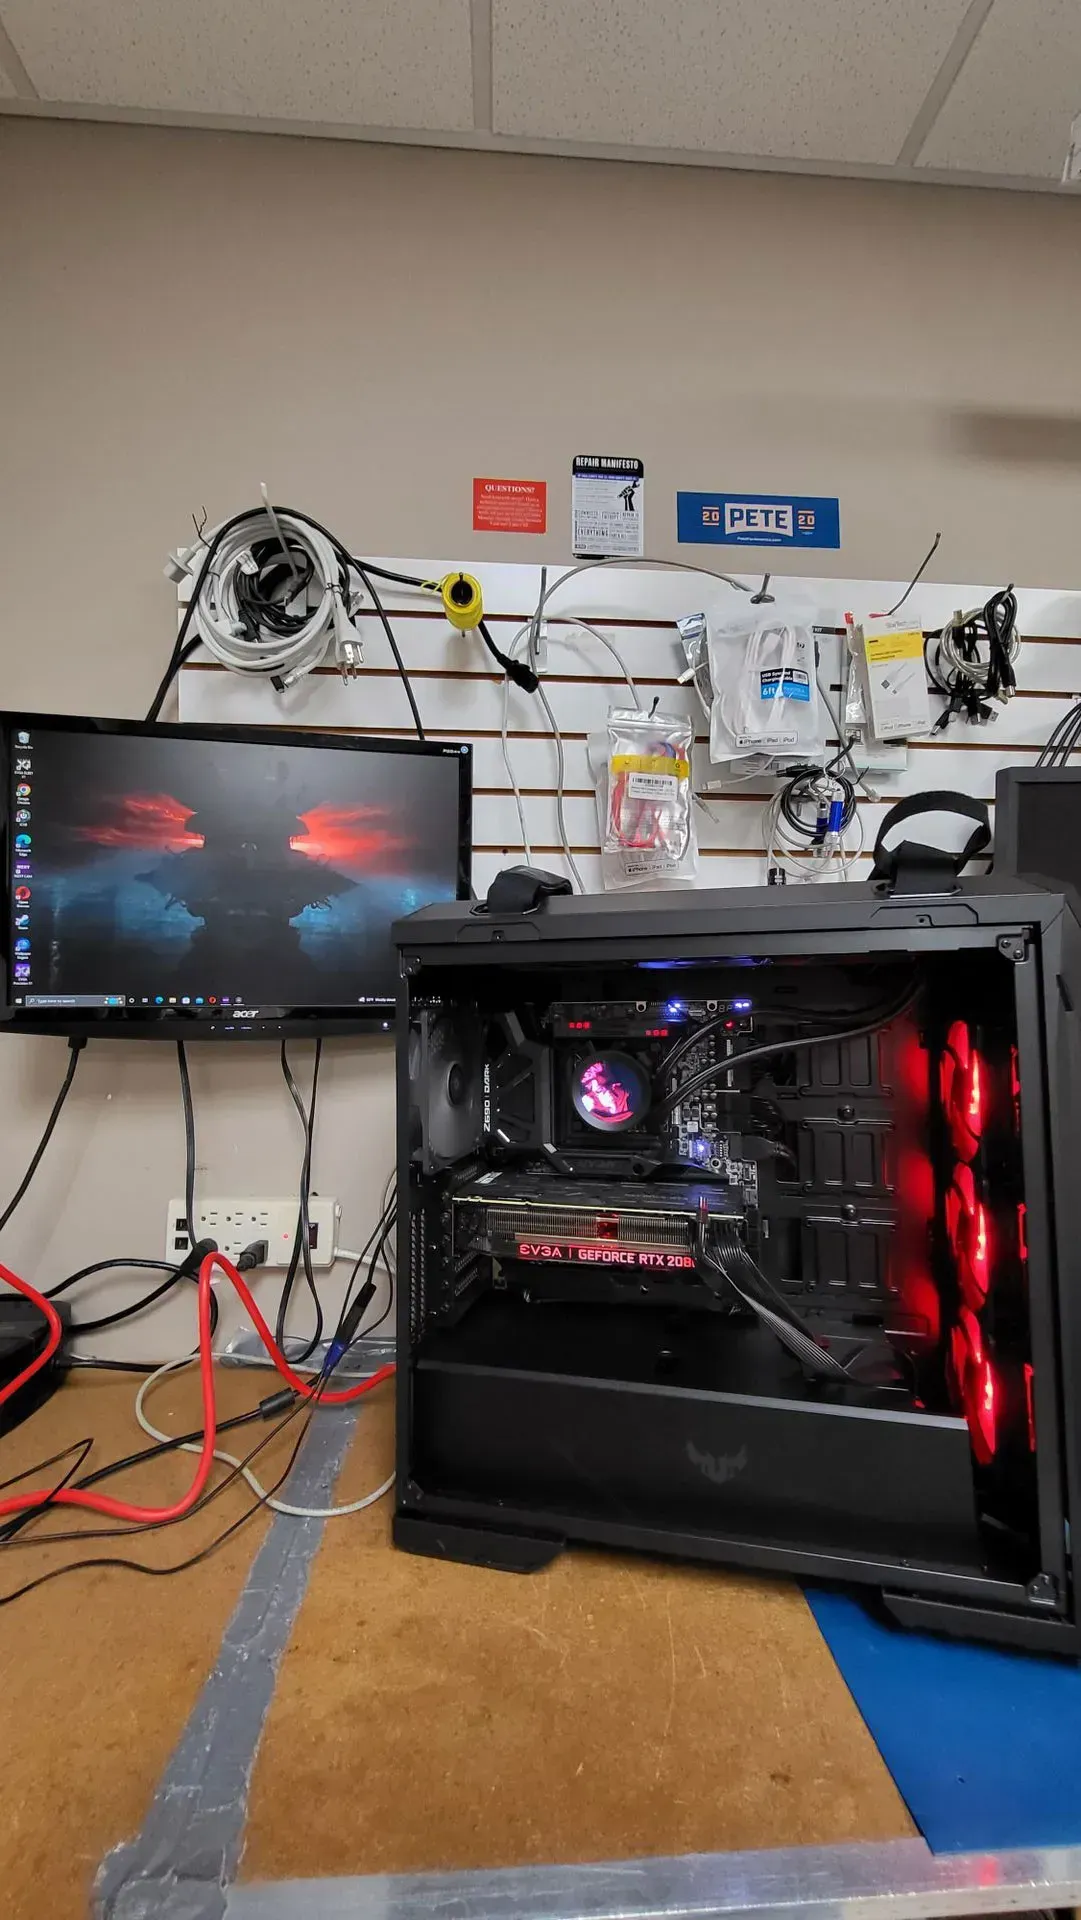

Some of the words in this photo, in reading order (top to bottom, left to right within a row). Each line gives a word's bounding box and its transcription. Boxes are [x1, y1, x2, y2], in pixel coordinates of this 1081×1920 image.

[575, 457, 600, 467] REPAIR
[601, 458, 639, 469] MANIFESTO
[485, 484, 535, 493] QUESTIONS?
[702, 511, 720, 522] 20
[730, 508, 788, 529] PETE
[798, 515, 815, 525] 20
[232, 1010, 259, 1018] acer
[519, 1244, 562, 1258] EVGA
[578, 1248, 635, 1264] GEFORCE
[639, 1253, 664, 1266] RTX
[667, 1256, 696, 1268] 208
